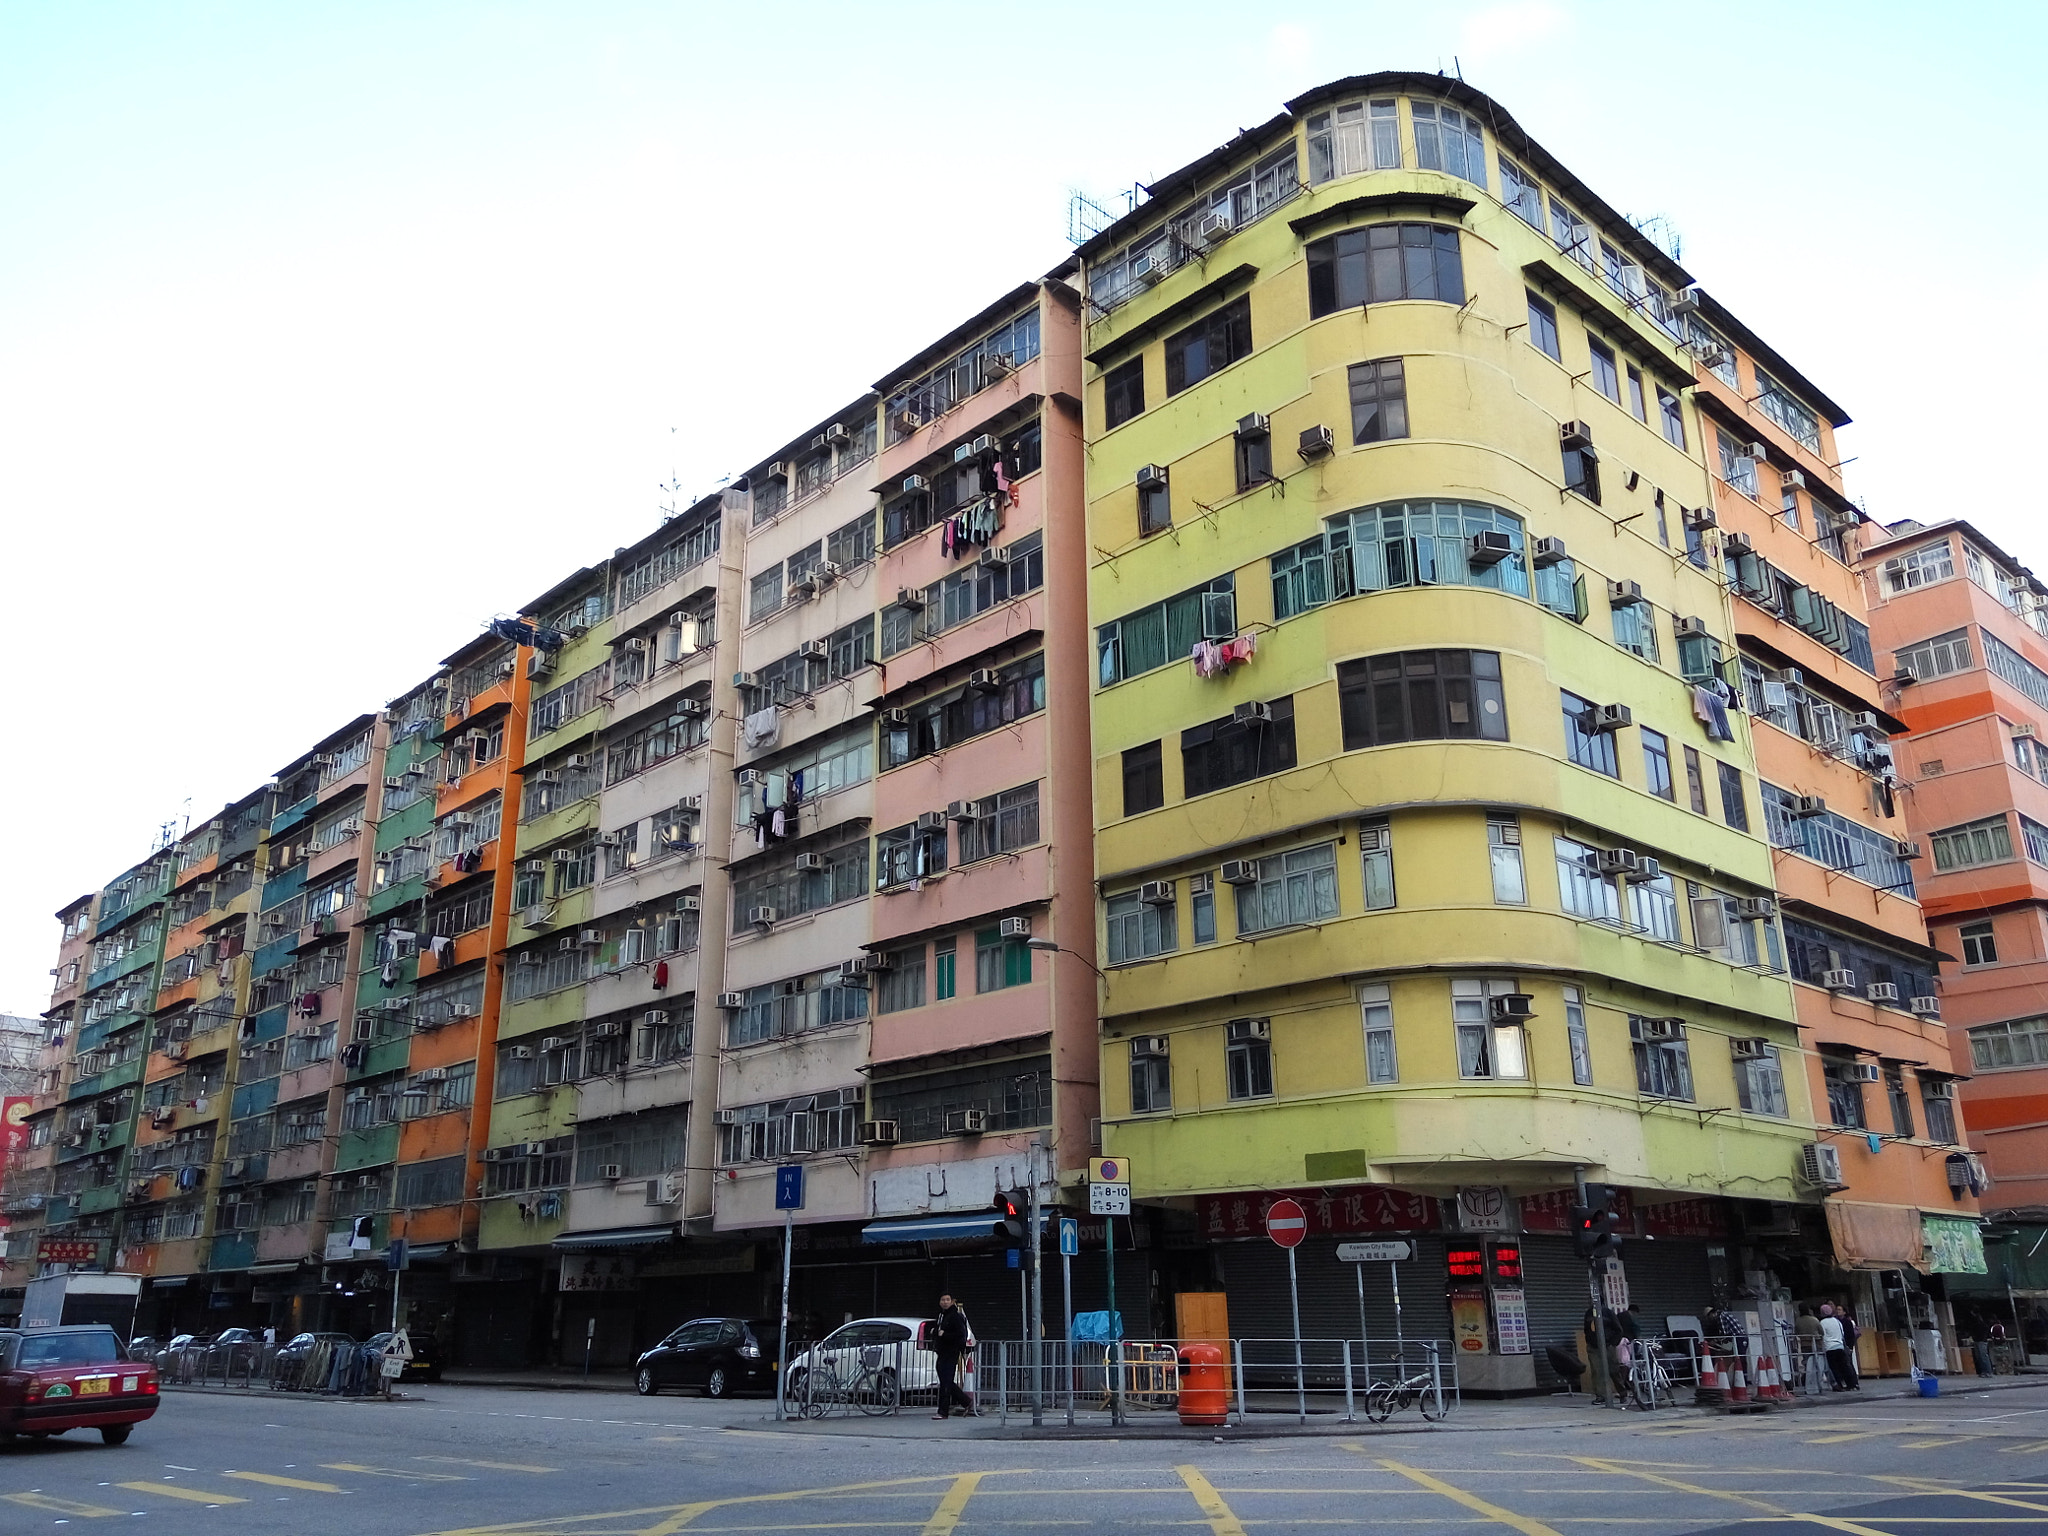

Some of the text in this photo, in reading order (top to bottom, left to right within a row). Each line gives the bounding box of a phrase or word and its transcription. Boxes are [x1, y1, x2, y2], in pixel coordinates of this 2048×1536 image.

[785, 1173, 793, 1183] IN
[783, 1187, 792, 1200] 入
[1105, 1187, 1128, 1197] 8-10
[1105, 1201, 1125, 1211] 5-7
